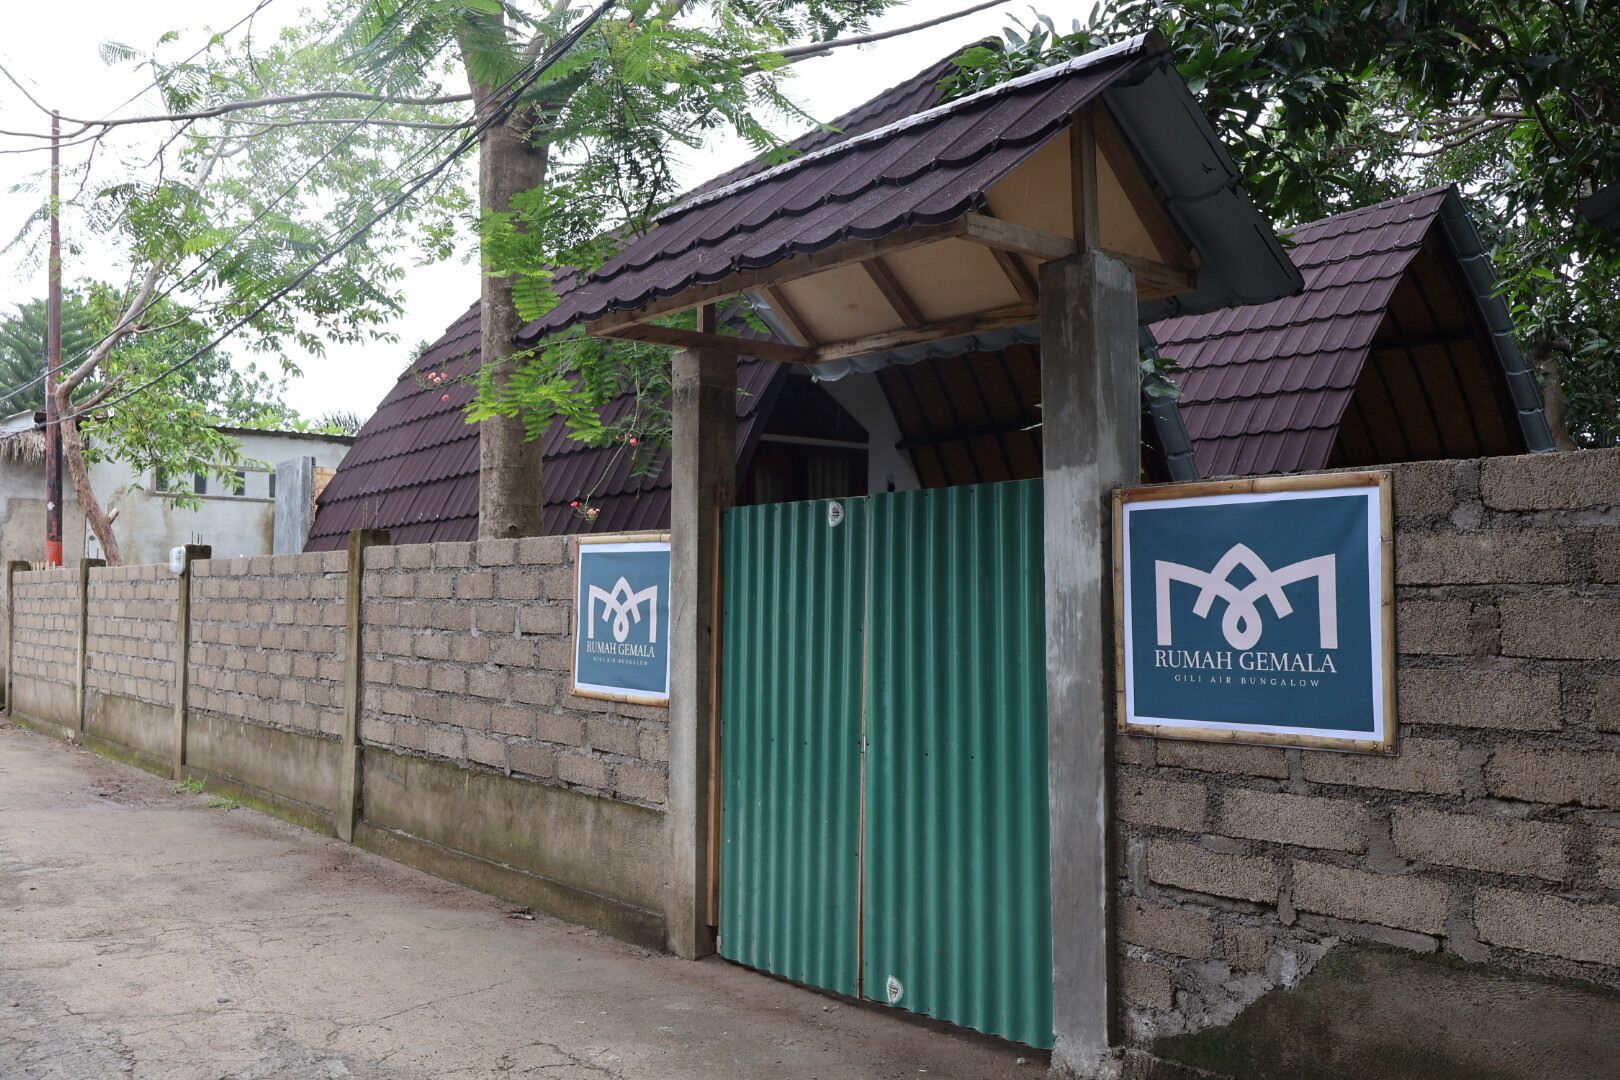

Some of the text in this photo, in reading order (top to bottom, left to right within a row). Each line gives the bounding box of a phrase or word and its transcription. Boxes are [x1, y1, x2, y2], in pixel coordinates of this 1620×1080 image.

[586, 640, 656, 658] RUMAH GEMALA
[1154, 649, 1338, 674] RUMAH GEMALA
[1174, 674, 1320, 687] GILI AIR BUNGALOW
